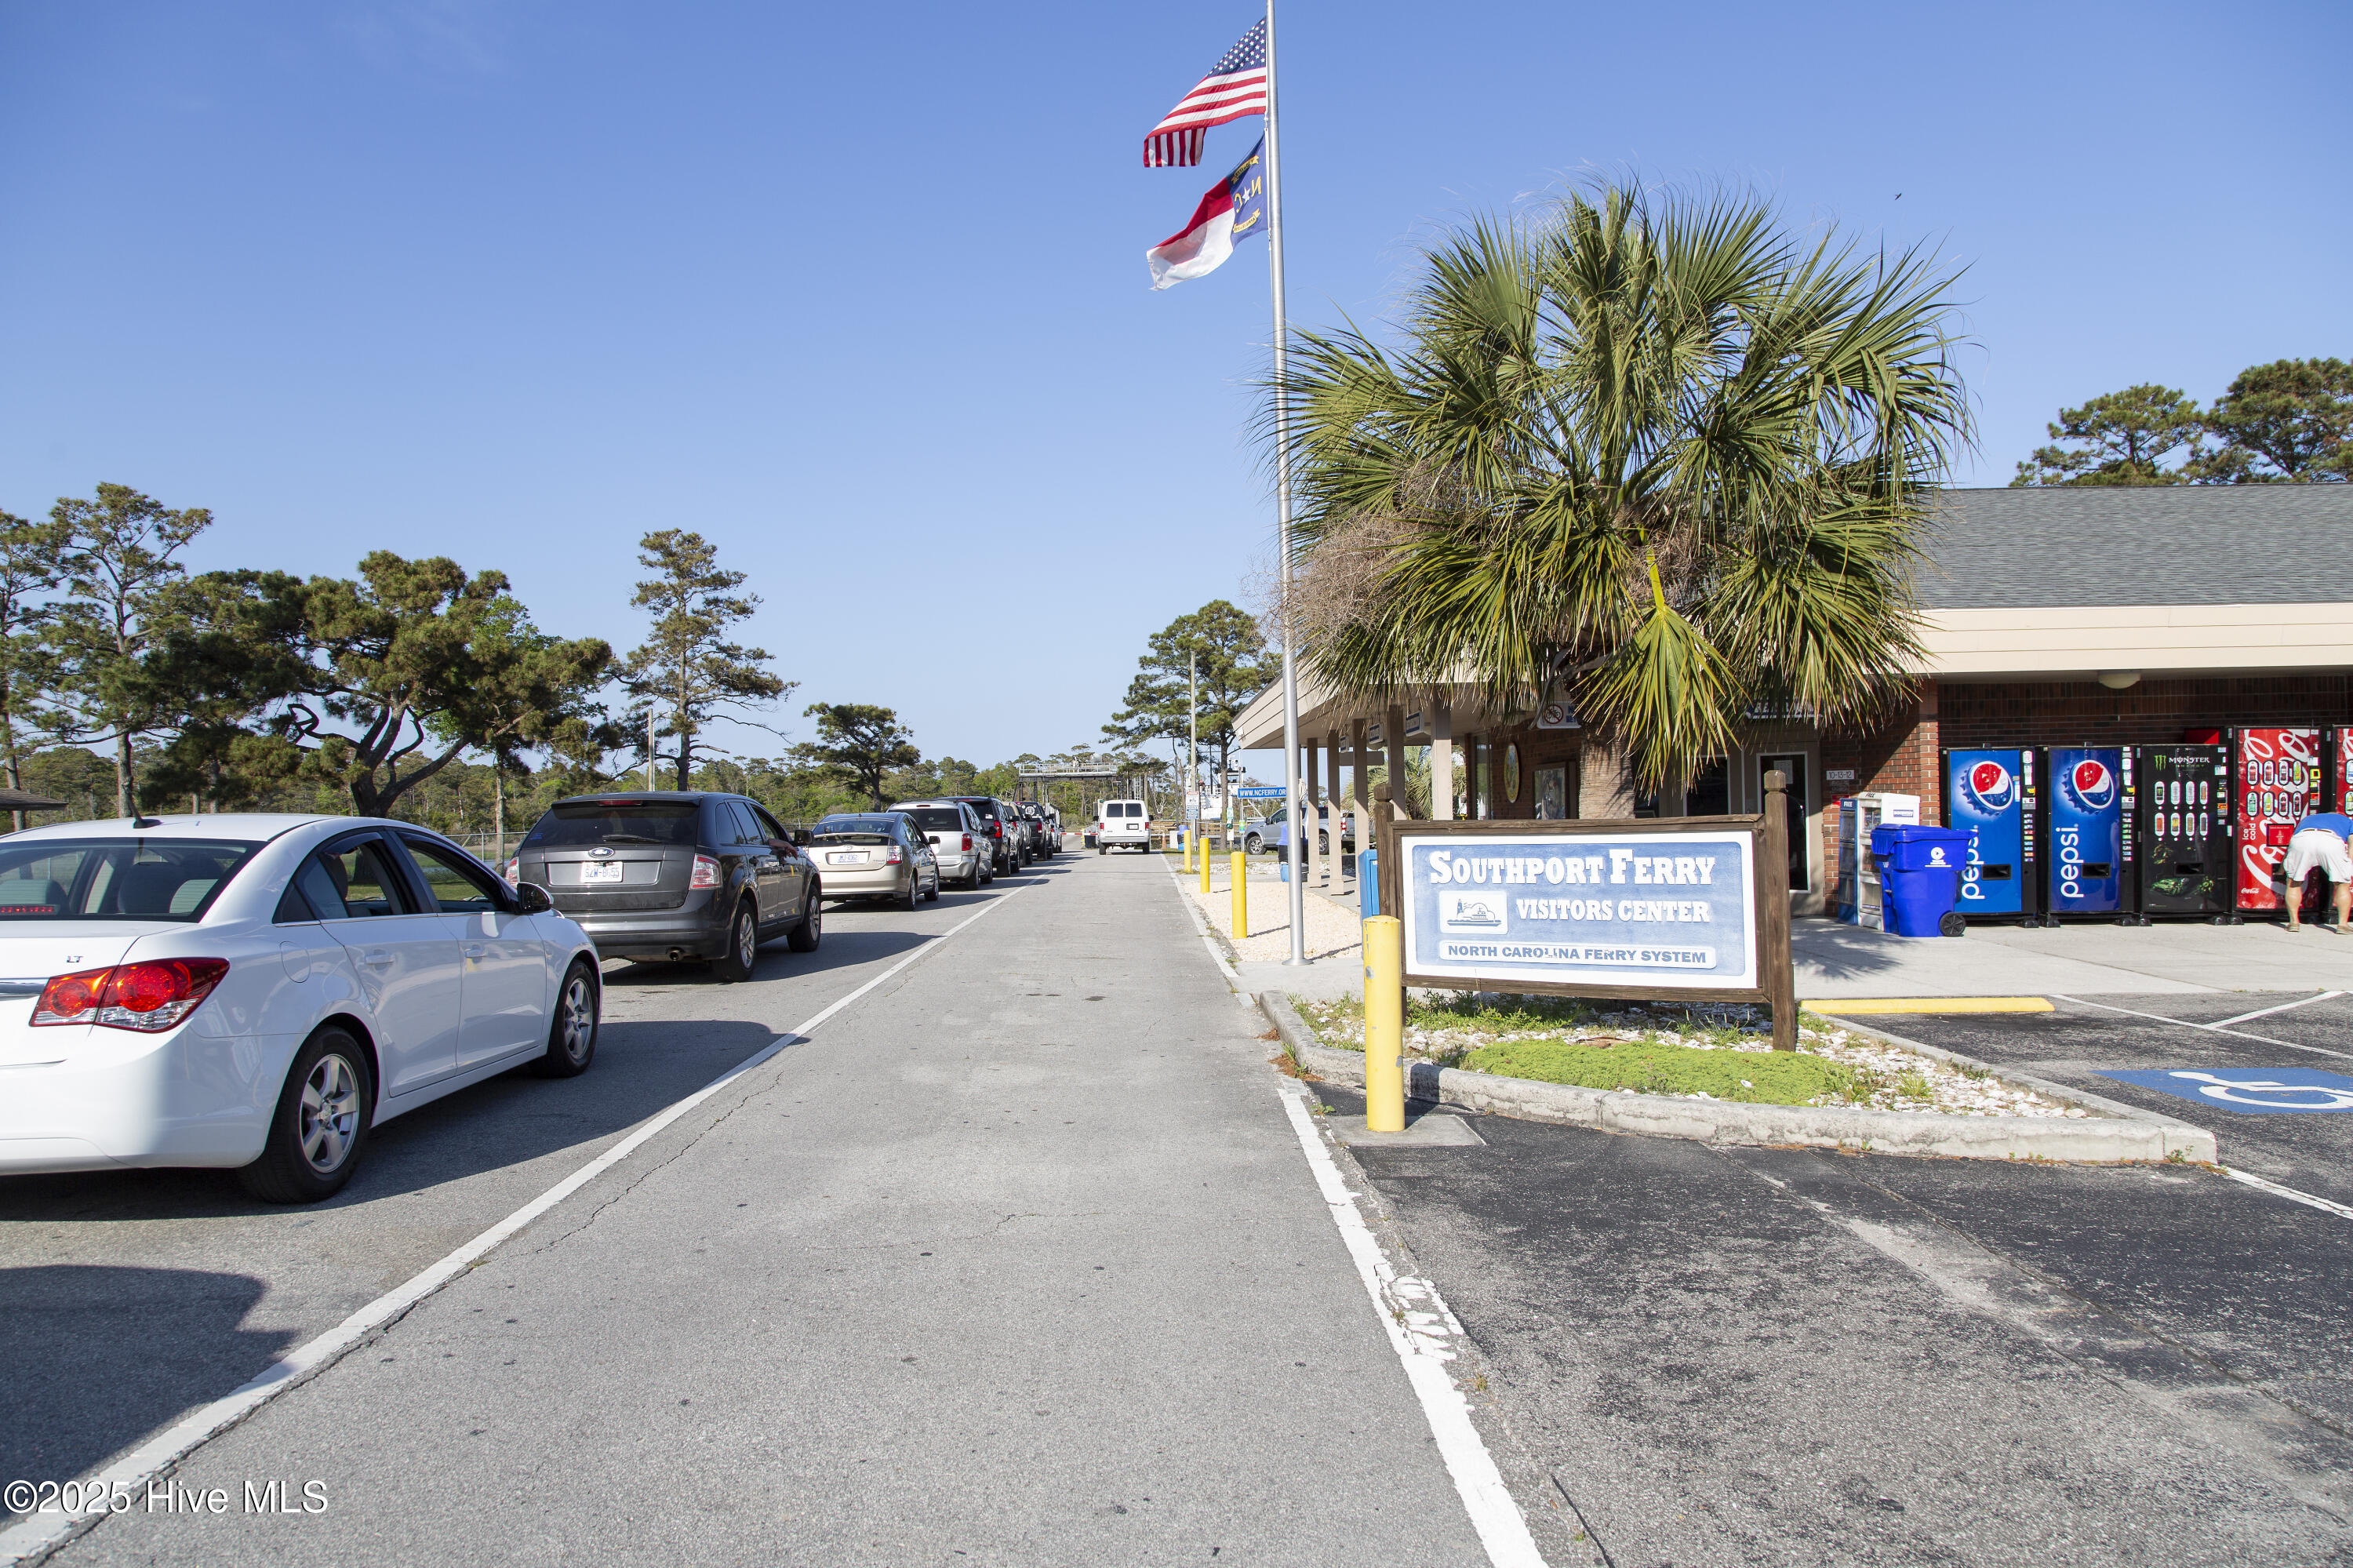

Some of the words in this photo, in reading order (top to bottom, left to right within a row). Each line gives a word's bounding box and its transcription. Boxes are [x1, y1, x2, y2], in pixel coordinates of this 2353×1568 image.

[2169, 755, 2210, 765] MONSTER
[1430, 850, 1603, 885] SOUTHPORT
[1609, 849, 1716, 885] FERRY
[2056, 827, 2084, 897] pepsi
[1516, 898, 1613, 922] VISITORS
[1617, 900, 1710, 922] CENTER
[1448, 944, 1497, 957] NORTH
[1584, 948, 1636, 961] FERRY
[1641, 950, 1707, 963] SYSTEM
